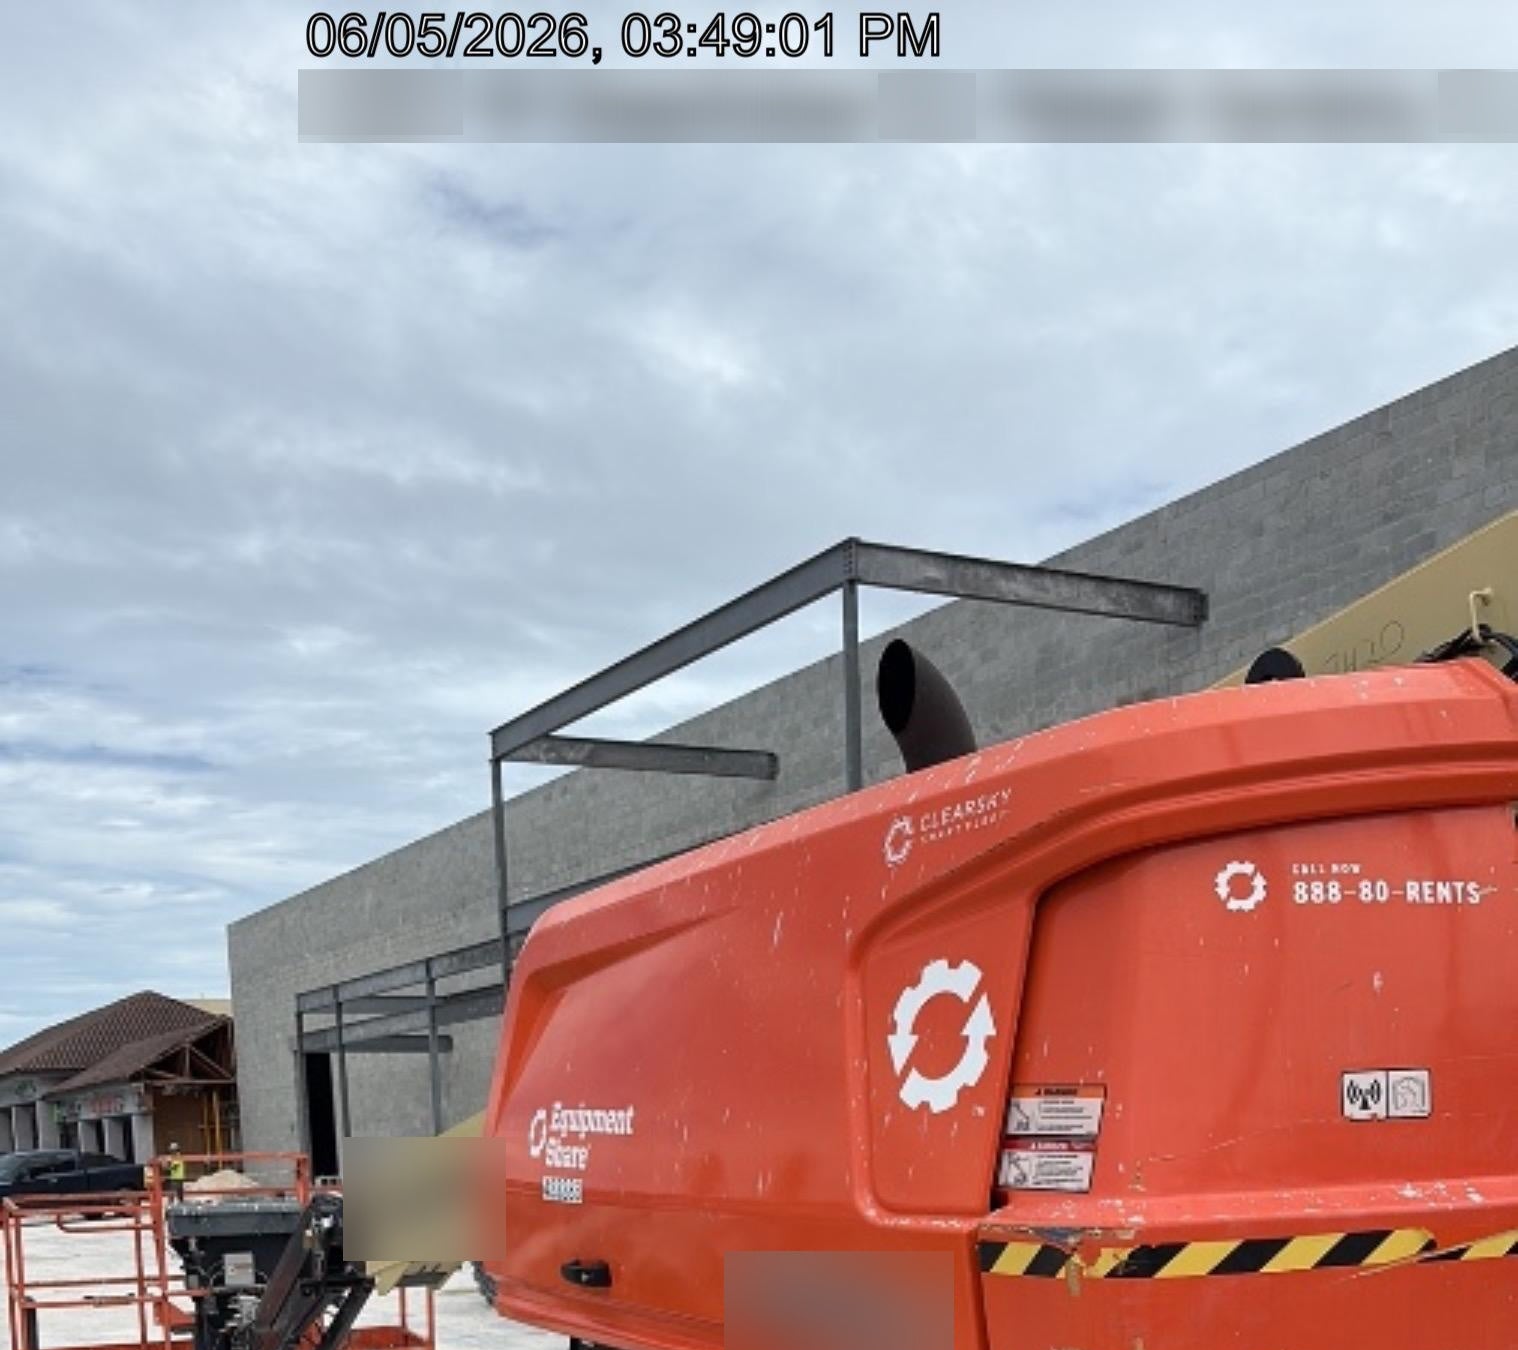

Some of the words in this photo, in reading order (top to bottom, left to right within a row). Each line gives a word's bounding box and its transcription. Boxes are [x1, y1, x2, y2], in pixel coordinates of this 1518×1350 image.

[920, 787, 1012, 832] CLEARSKY
[1293, 880, 1481, 904] 888-80-RENTS
[550, 1100, 635, 1140] Equipment
[545, 1136, 589, 1171] Share
